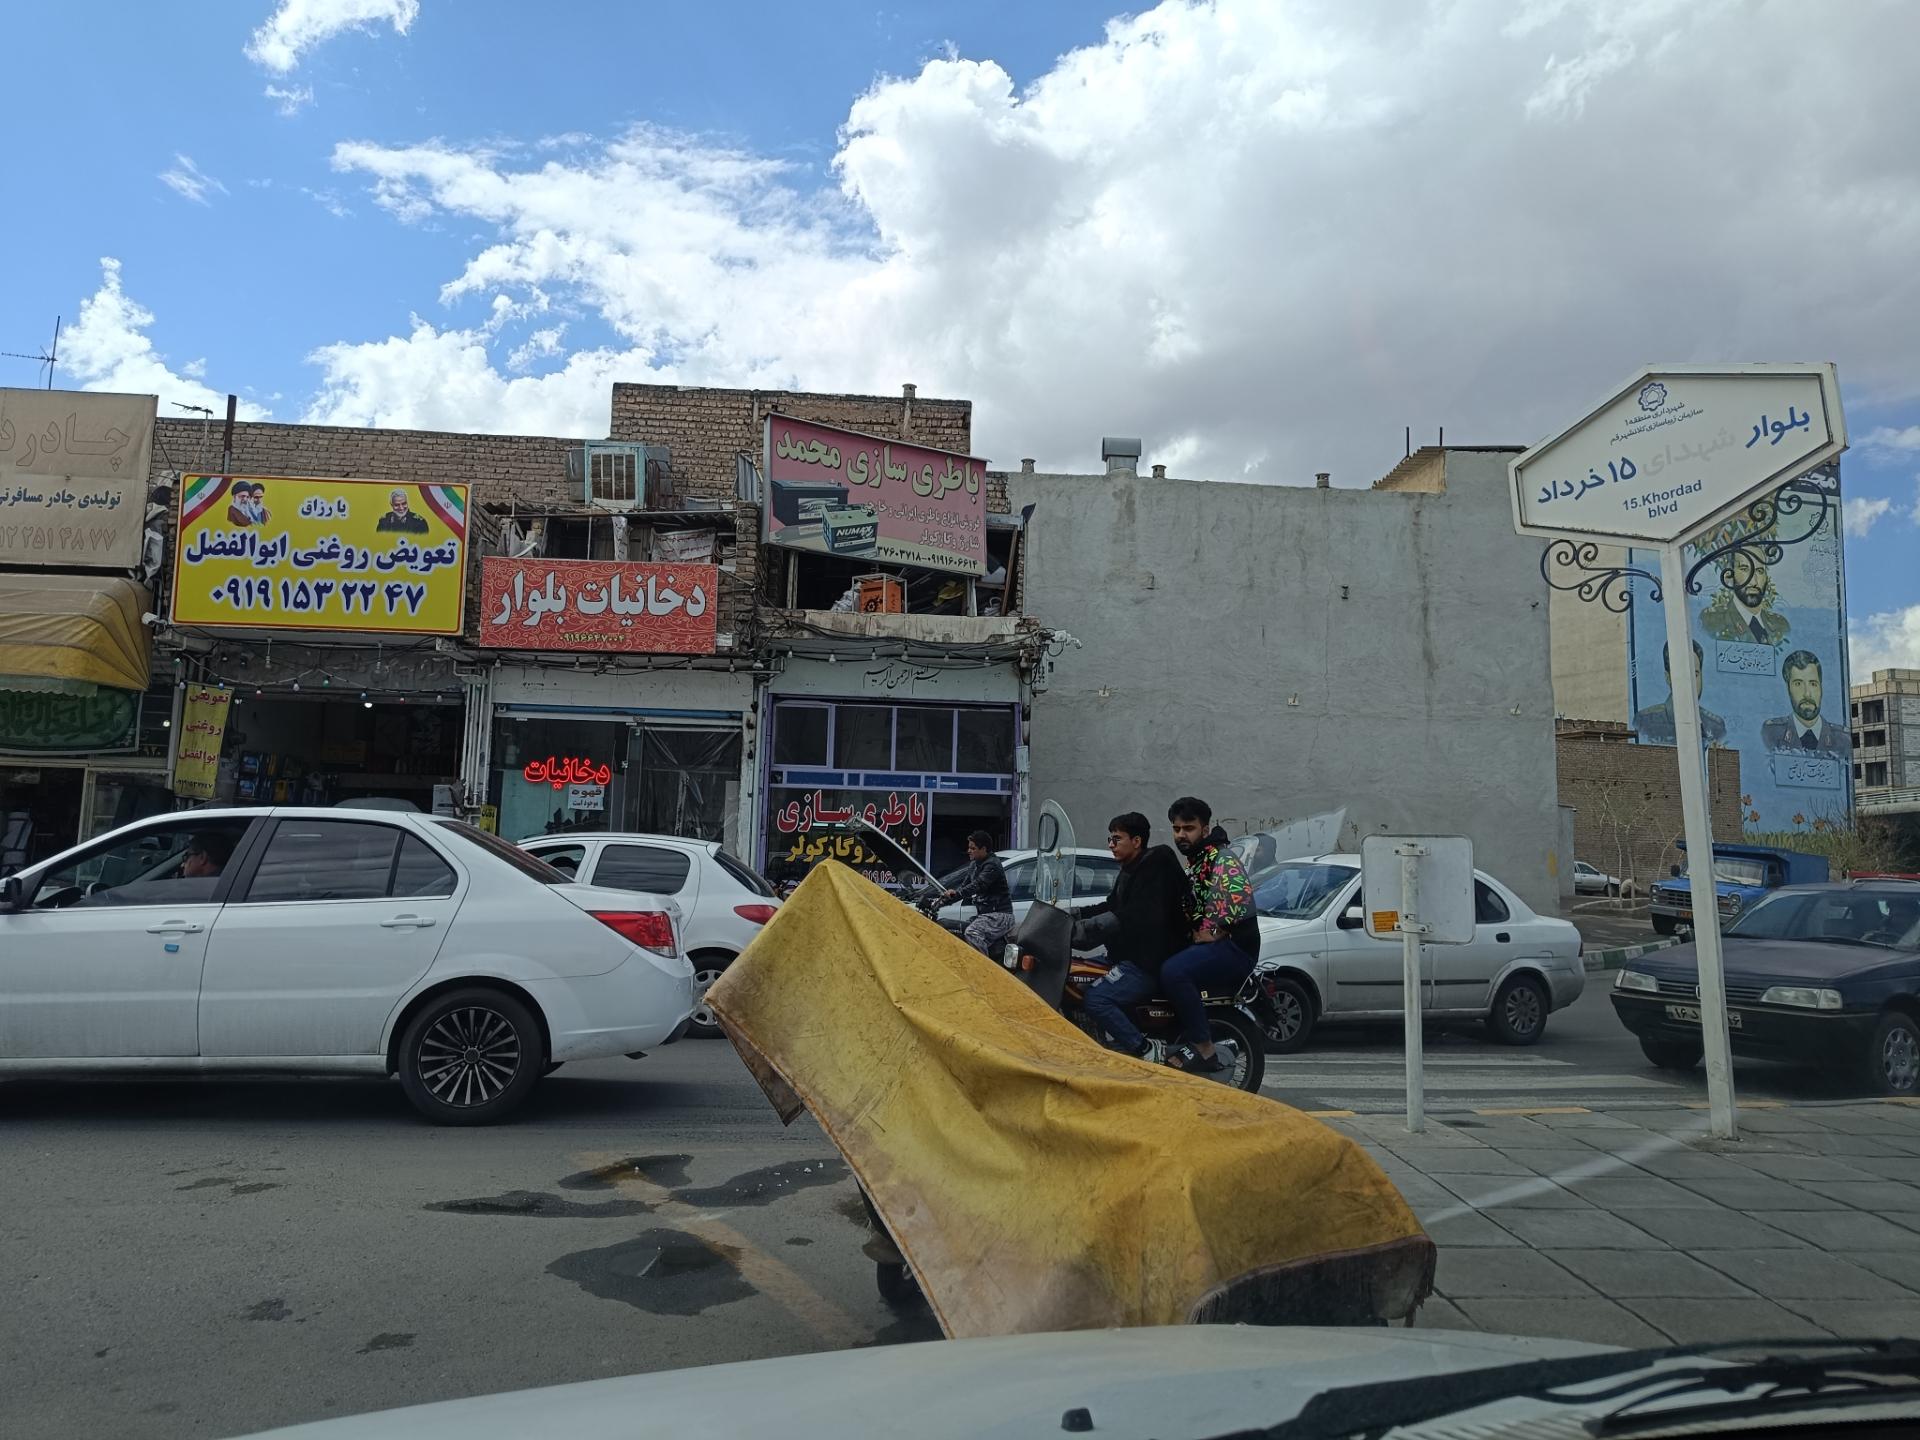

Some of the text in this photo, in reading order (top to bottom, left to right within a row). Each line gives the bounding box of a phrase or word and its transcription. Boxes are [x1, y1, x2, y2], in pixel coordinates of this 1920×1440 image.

[1628, 414, 1651, 425] منطقه
[1652, 402, 1686, 419] شهرداری
[1678, 409, 1704, 421] سازمان
[15, 412, 131, 473] چادر
[1537, 406, 1811, 504] بلوار شهدای ۱۵ خرداد
[776, 431, 979, 504] باطری سازی محمد
[0, 486, 122, 510] تولیدی چادر مسافرت
[1622, 480, 1702, 511] 15.Khordad
[301, 498, 346, 518] یا رزاق
[895, 503, 917, 520] ایرانی
[918, 507, 939, 525] باطری
[1648, 502, 1678, 519] blvd
[941, 510, 959, 528] انواع
[959, 514, 980, 532] فروش
[89, 528, 117, 551] ۷۷
[960, 534, 980, 552] شارژ
[186, 530, 456, 572] تعویض روغنی ابوالفضل
[211, 577, 425, 615] ۰۹۱۹ ۱۵۳ ۲۲ ۴۷
[491, 570, 706, 628] دخانیات بلوار
[189, 692, 230, 706] تعویض
[185, 720, 222, 736] روغنی
[178, 748, 220, 765] ابوالفضل
[524, 756, 611, 789] دخانیات
[571, 786, 602, 799] قهوه
[583, 800, 599, 808] موجود
[777, 789, 925, 837] باطری سازی
[1180, 1046, 1195, 1061] FILA
